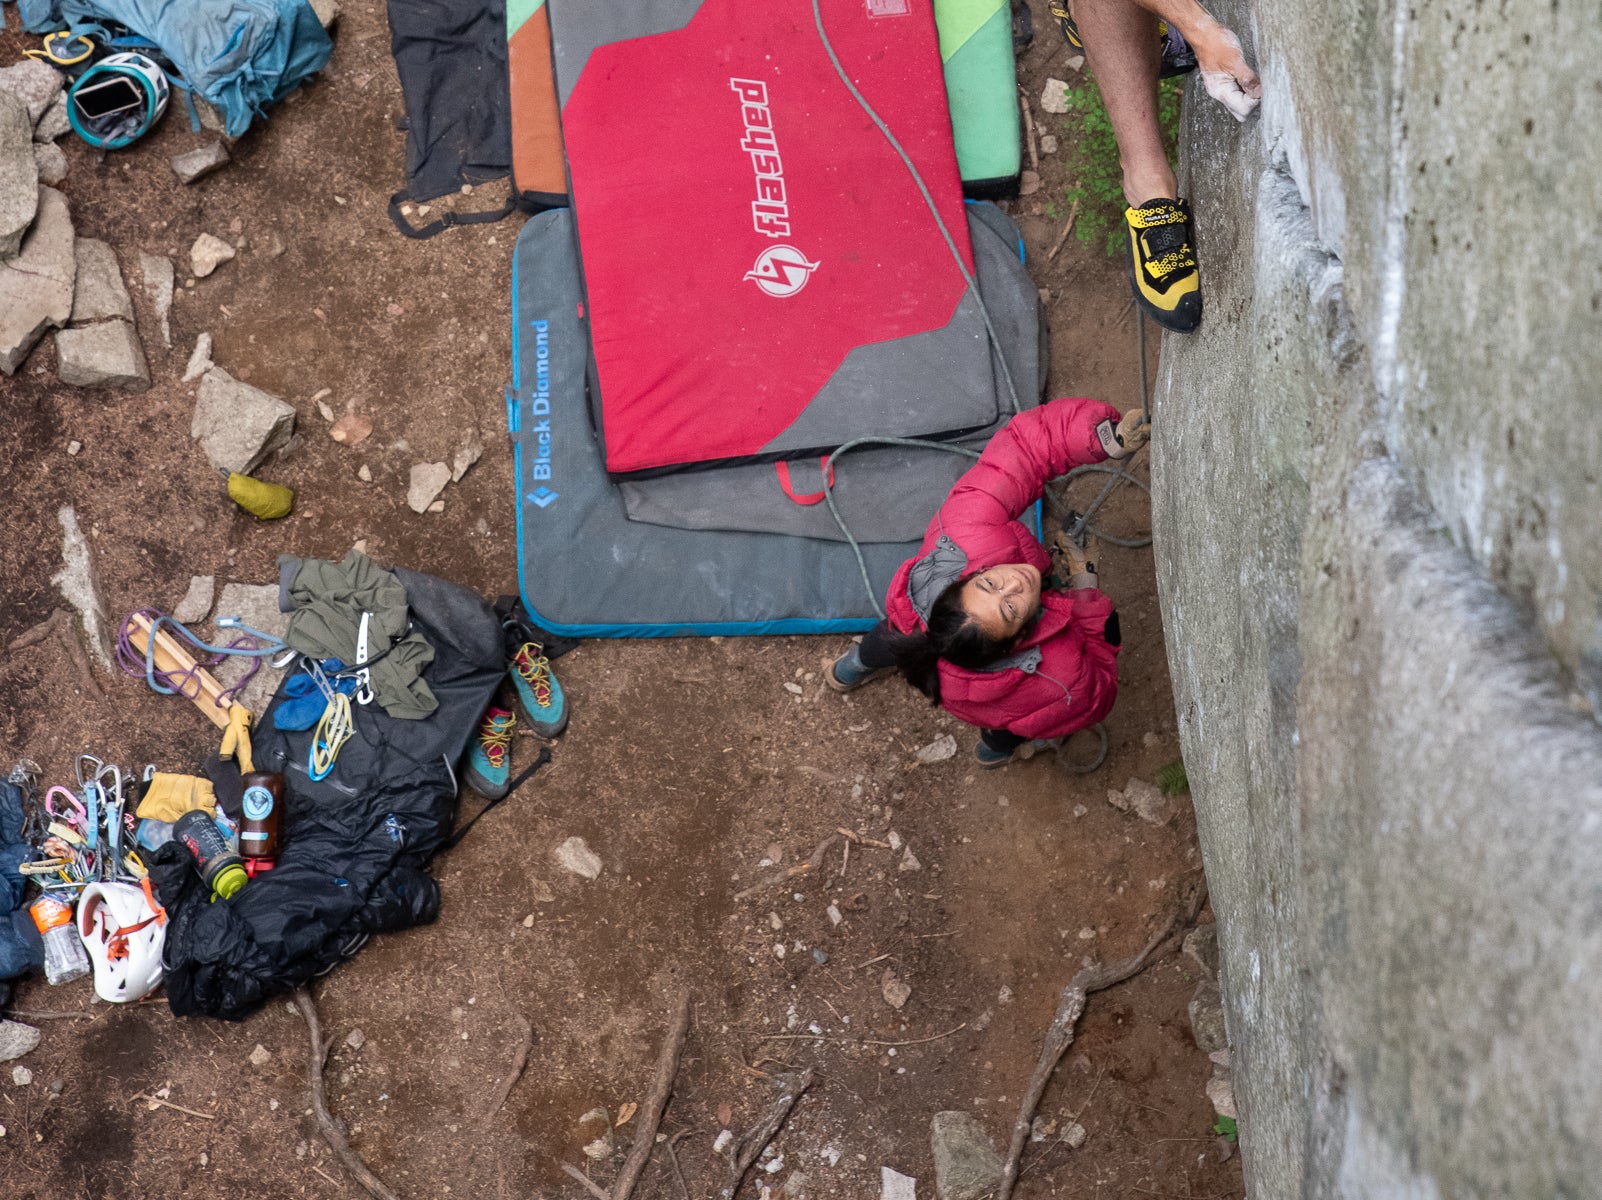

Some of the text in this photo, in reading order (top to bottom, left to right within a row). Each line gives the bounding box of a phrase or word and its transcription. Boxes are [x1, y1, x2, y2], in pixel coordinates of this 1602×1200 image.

[730, 77, 791, 238] flashed
[531, 319, 551, 481] Black Diamond
